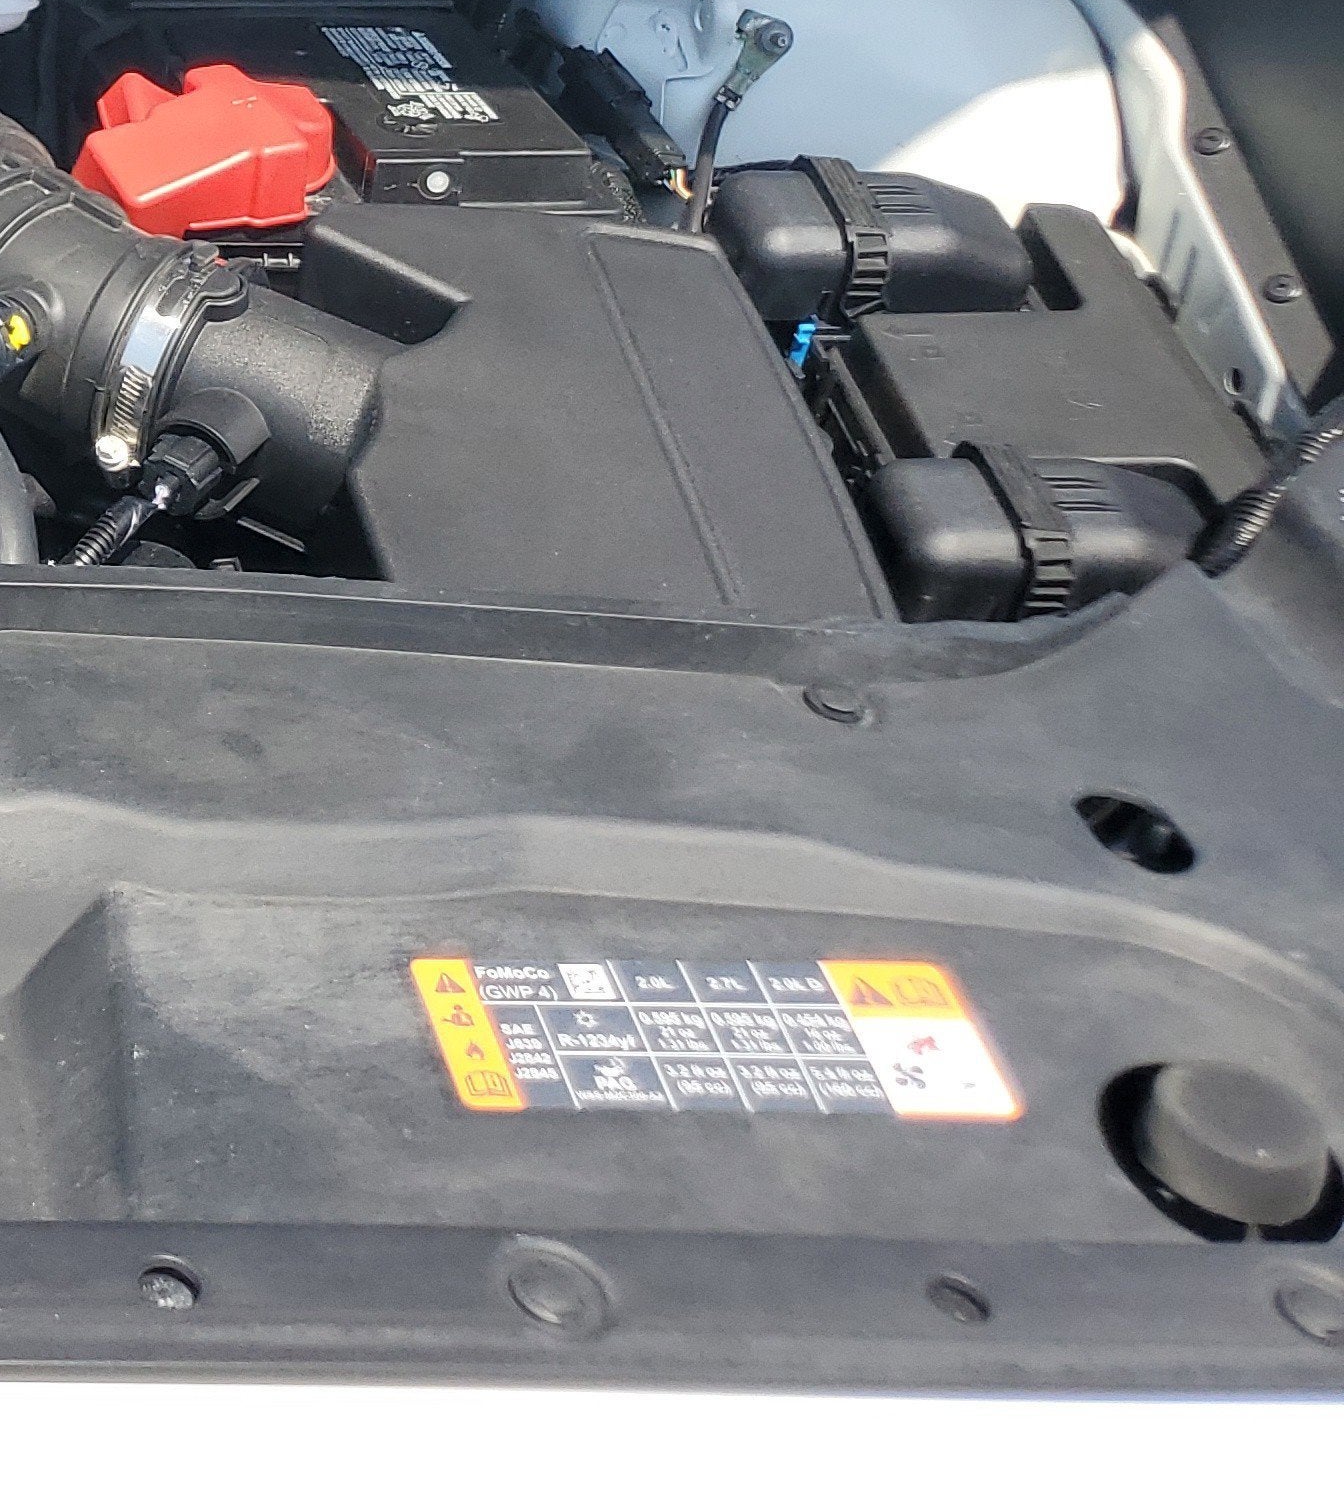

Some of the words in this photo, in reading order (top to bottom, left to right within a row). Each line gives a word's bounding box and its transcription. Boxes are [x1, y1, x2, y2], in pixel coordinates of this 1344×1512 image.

[473, 966, 551, 981] FoMoCo
[635, 976, 676, 990] 2.0L
[478, 984, 531, 1001] (GWP
[536, 985, 559, 1001] 4)
[500, 1023, 535, 1035] SAE
[556, 1034, 637, 1050] R-1234yf
